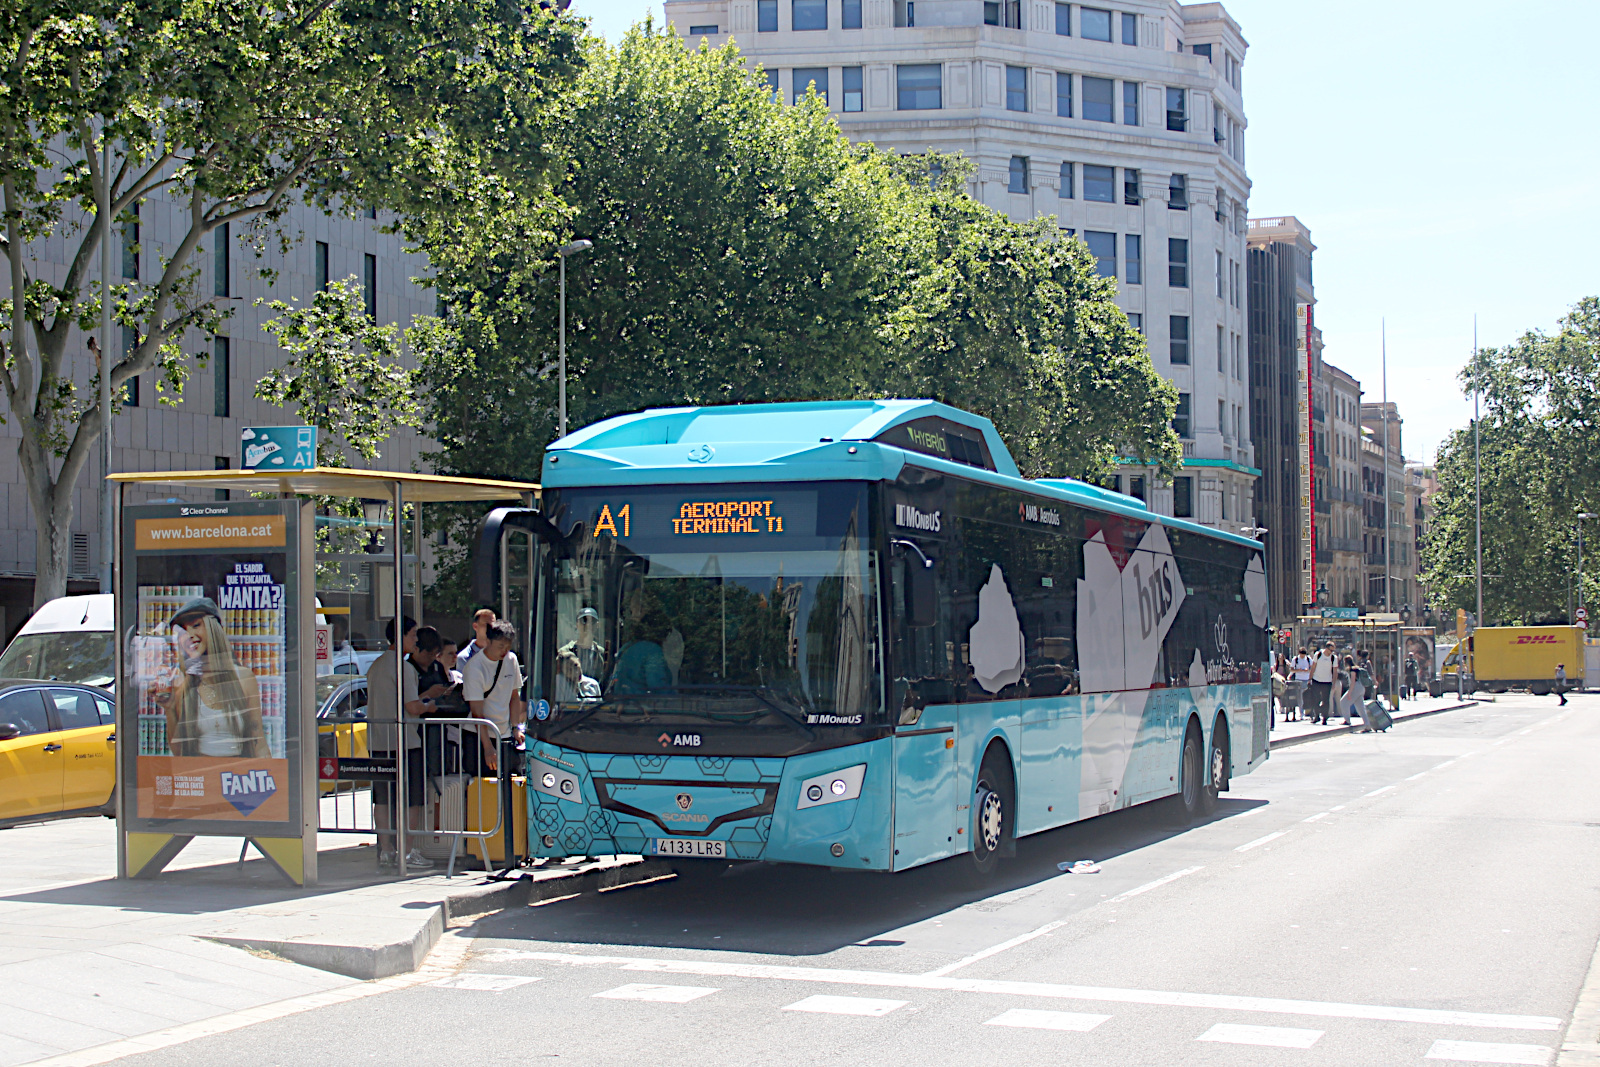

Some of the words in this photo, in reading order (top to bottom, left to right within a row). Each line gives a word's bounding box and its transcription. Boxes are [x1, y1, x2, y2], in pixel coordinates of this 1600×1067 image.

[293, 451, 312, 466] A1
[680, 501, 773, 518] AEROPORT
[1026, 504, 1038, 522] AMB
[593, 504, 630, 537] A1
[672, 517, 759, 534] TERMINAL
[765, 516, 784, 532] T1
[151, 524, 272, 540] www.barcelona.cat
[235, 564, 242, 573] EL
[243, 564, 263, 573] SABOR
[226, 575, 239, 585] QUE
[220, 586, 280, 609] WANTA?
[1516, 635, 1557, 644] DHL
[673, 734, 701, 746] AMB
[221, 770, 276, 796] FANTA
[661, 812, 709, 823] SCANIA
[660, 840, 693, 854] 4133
[697, 841, 722, 855] LRS
